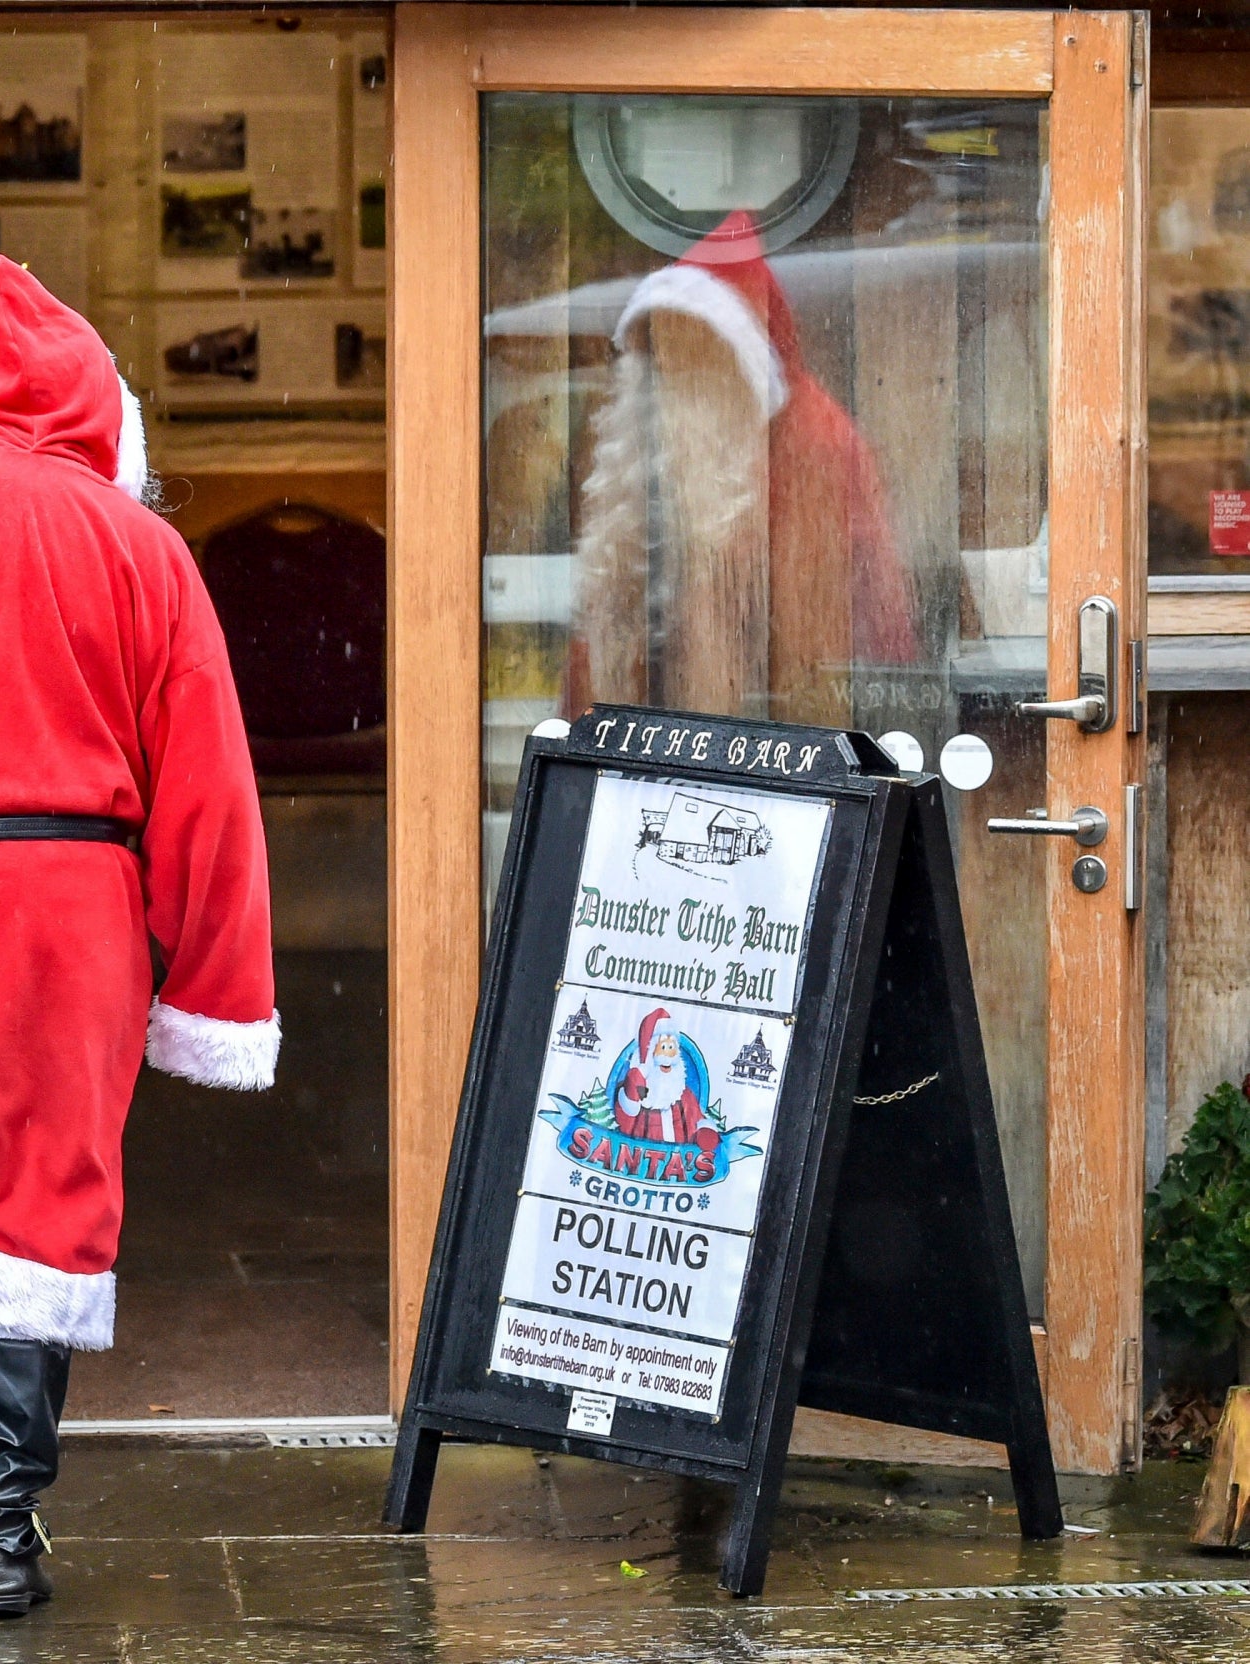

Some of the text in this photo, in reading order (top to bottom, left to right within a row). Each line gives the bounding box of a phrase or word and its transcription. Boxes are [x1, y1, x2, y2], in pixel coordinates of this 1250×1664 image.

[595, 718, 823, 775] TITHE BARN
[575, 883, 800, 955] Dunster Tithe Barn
[585, 943, 777, 1004] Community Hall
[568, 1126, 718, 1184] SANTA'S
[585, 1175, 694, 1213] GROTTO
[552, 1207, 710, 1270] POLLING
[552, 1260, 692, 1318] STATION
[507, 1317, 548, 1346] Viewing
[550, 1327, 563, 1344] of
[563, 1329, 580, 1348] the
[610, 1338, 624, 1361] by
[625, 1346, 693, 1371] appointment
[694, 1357, 717, 1380] only
[622, 1372, 632, 1384] or
[639, 1371, 653, 1389] Tel:
[654, 1375, 680, 1394] 07983
[681, 1380, 713, 1400] 822683
